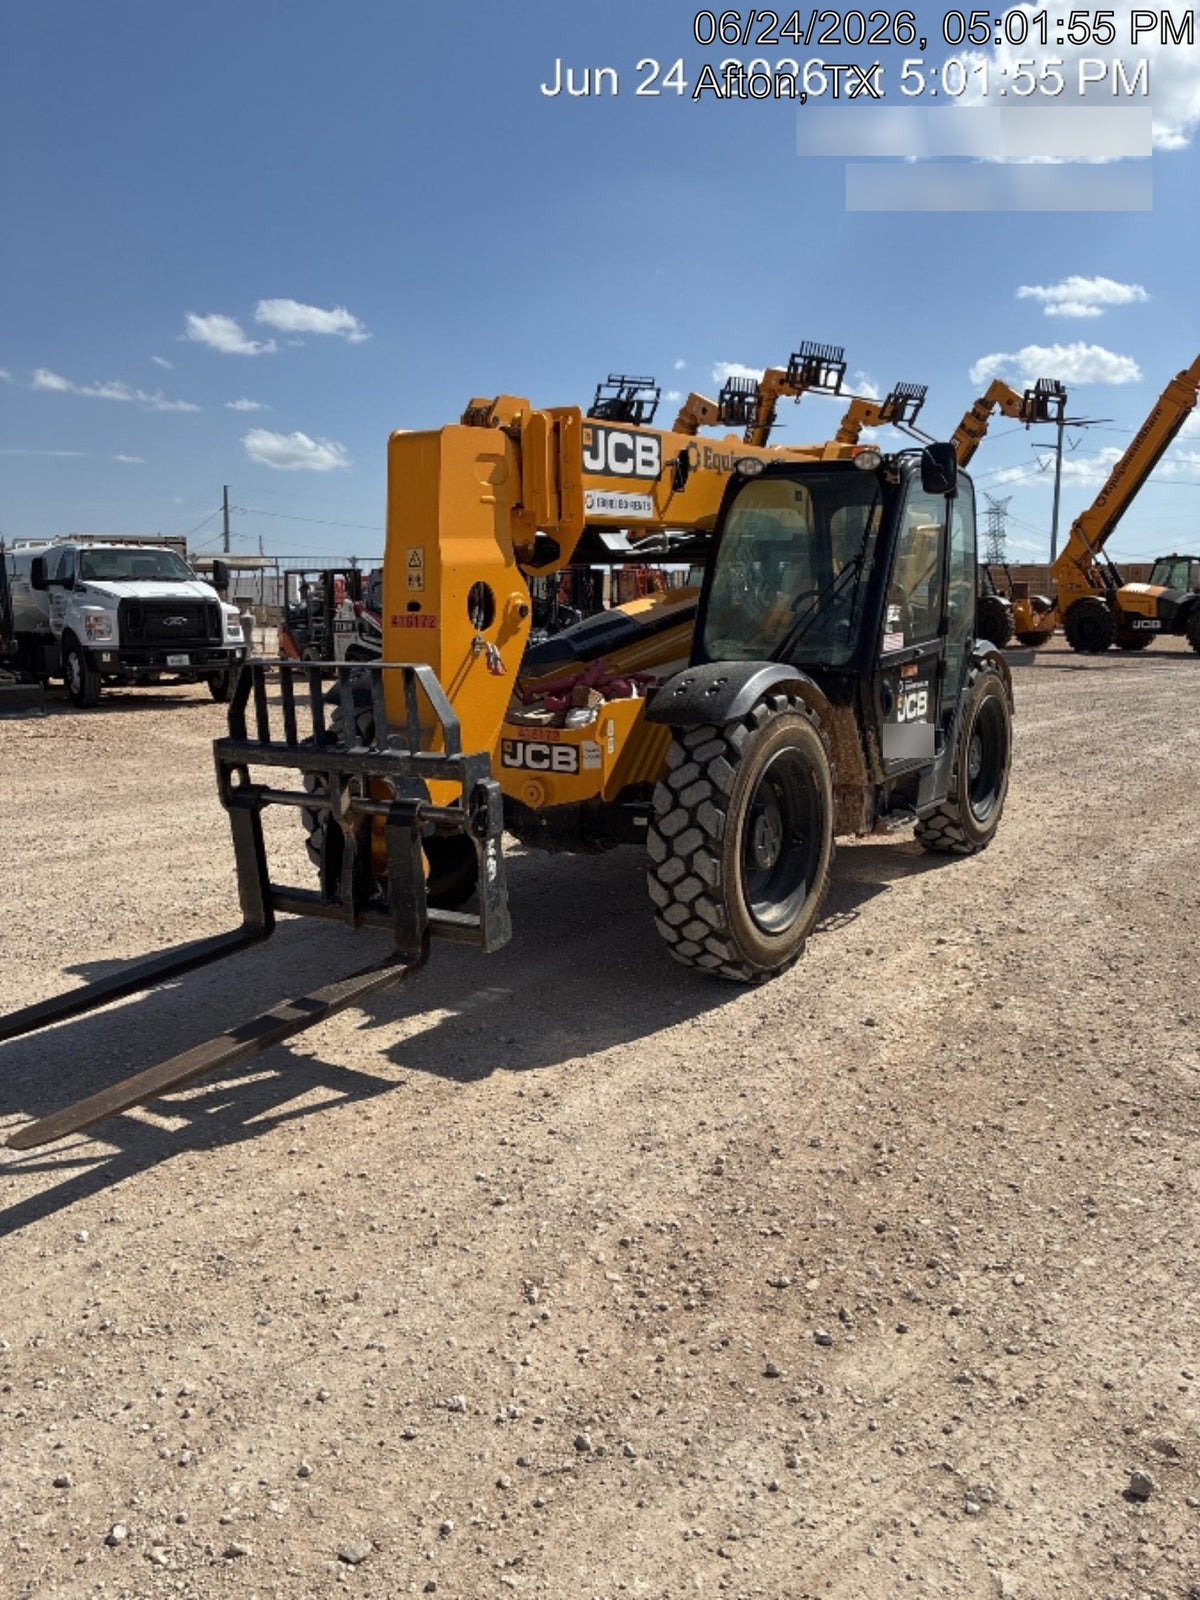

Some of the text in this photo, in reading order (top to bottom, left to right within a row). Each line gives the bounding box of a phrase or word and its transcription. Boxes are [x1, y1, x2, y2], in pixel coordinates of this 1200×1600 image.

[583, 430, 661, 476] JCB
[704, 447, 738, 473] Equi
[897, 691, 927, 722] JCB
[504, 742, 577, 772] JCB
